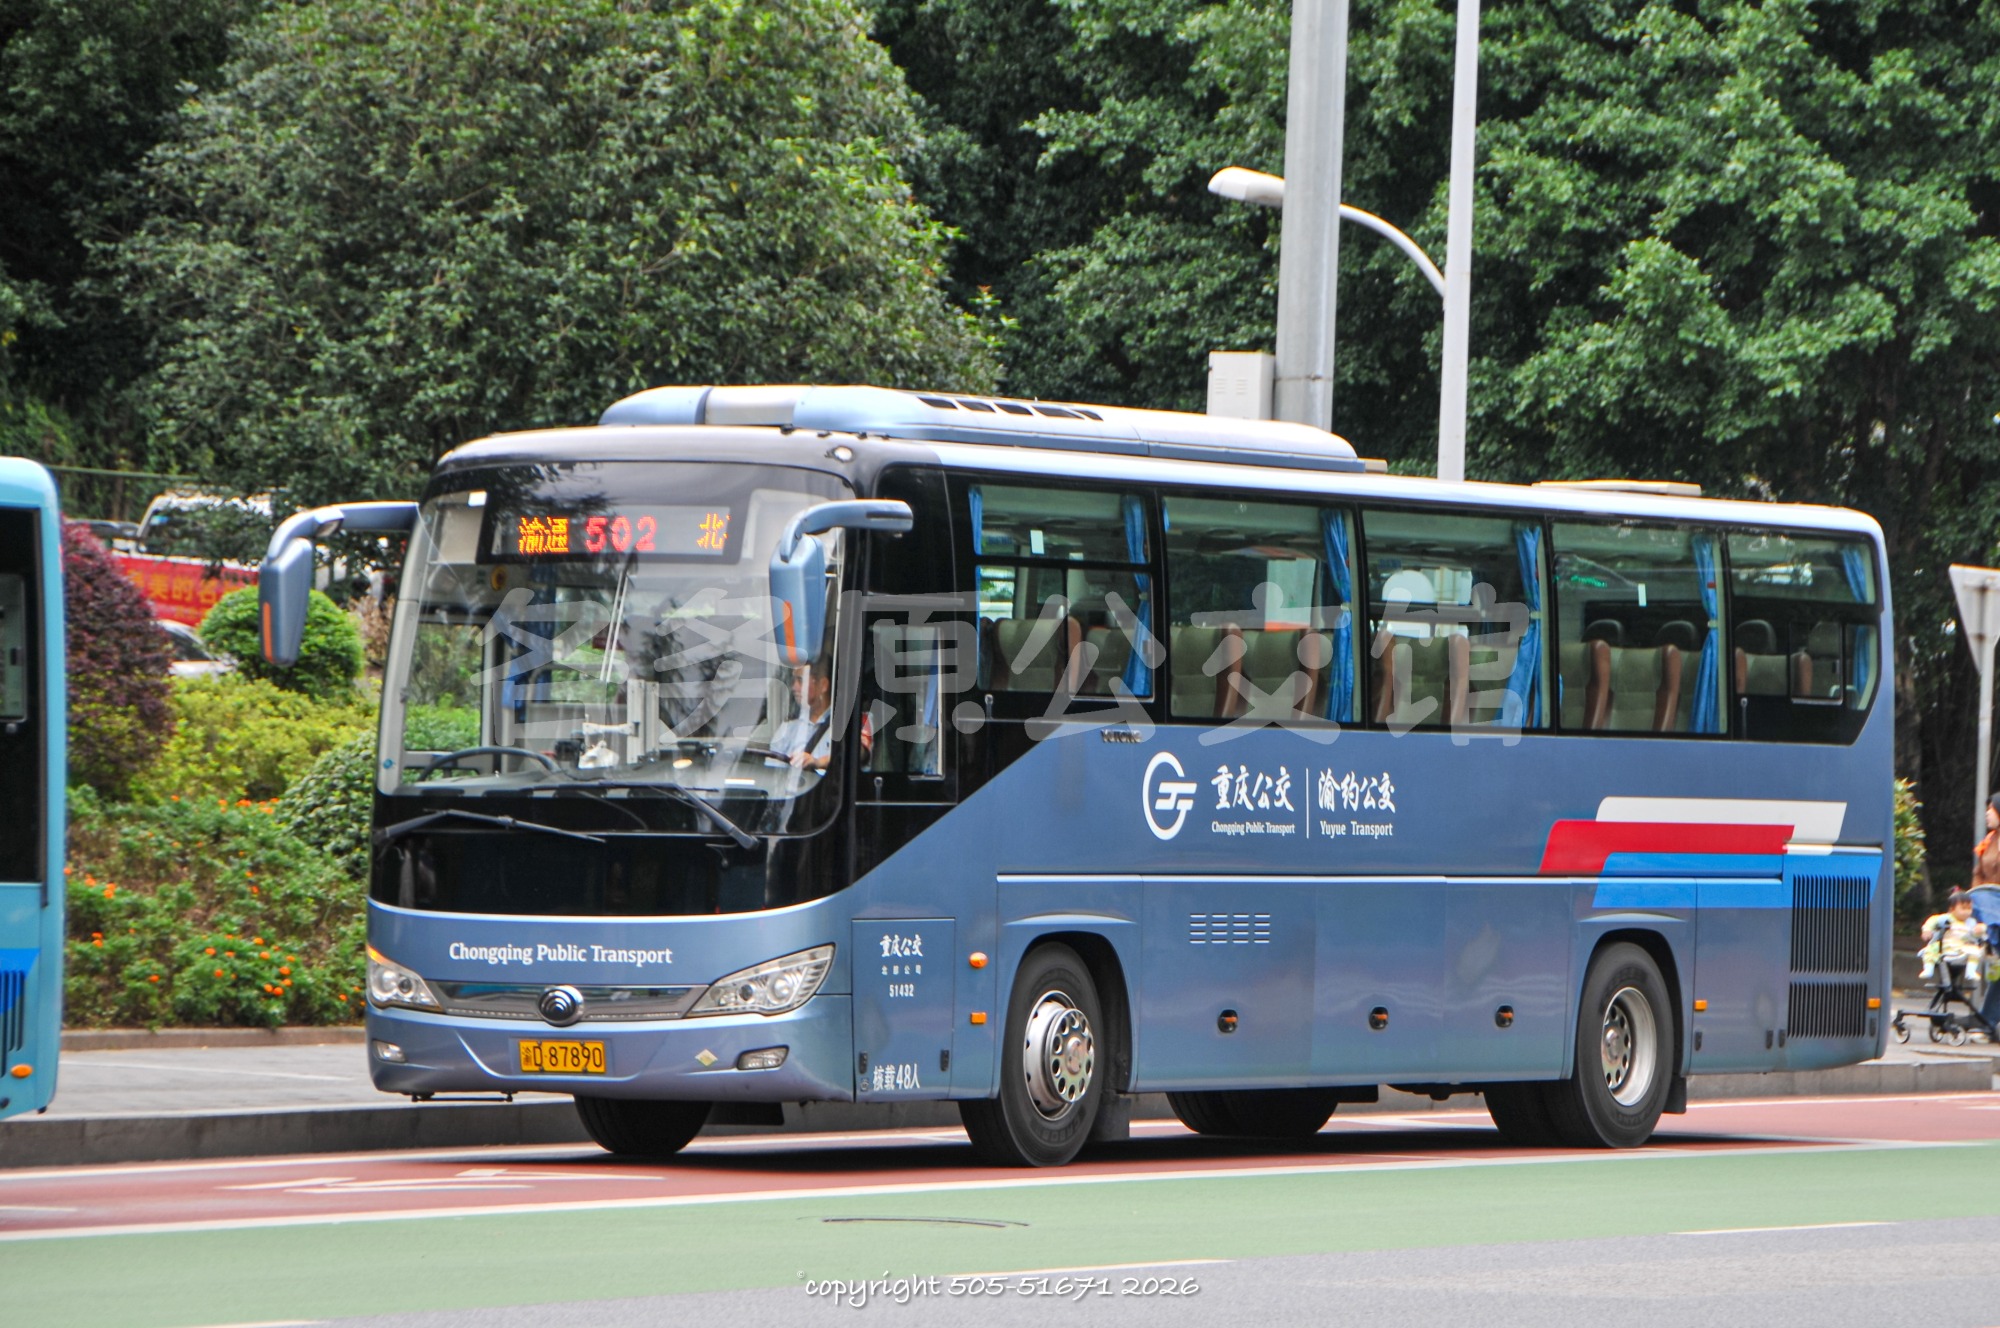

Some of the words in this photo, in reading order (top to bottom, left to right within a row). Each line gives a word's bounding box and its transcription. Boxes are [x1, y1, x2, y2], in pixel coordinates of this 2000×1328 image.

[585, 515, 656, 552] 502
[697, 513, 731, 549] 北
[1211, 765, 1294, 811] 重庆公交
[1318, 768, 1395, 813] 渝约公交
[1212, 821, 1245, 835] Chongqing
[1246, 822, 1265, 833] Public
[1266, 822, 1295, 836] Transport
[1320, 821, 1346, 838] Yuyue
[1351, 821, 1393, 839] Transport
[449, 943, 533, 965] Chongqing
[537, 944, 587, 962] Public
[590, 945, 672, 967] Transport
[880, 934, 923, 957] 重庆公交
[889, 984, 914, 997] 51432
[873, 1064, 920, 1091] 核载48人
